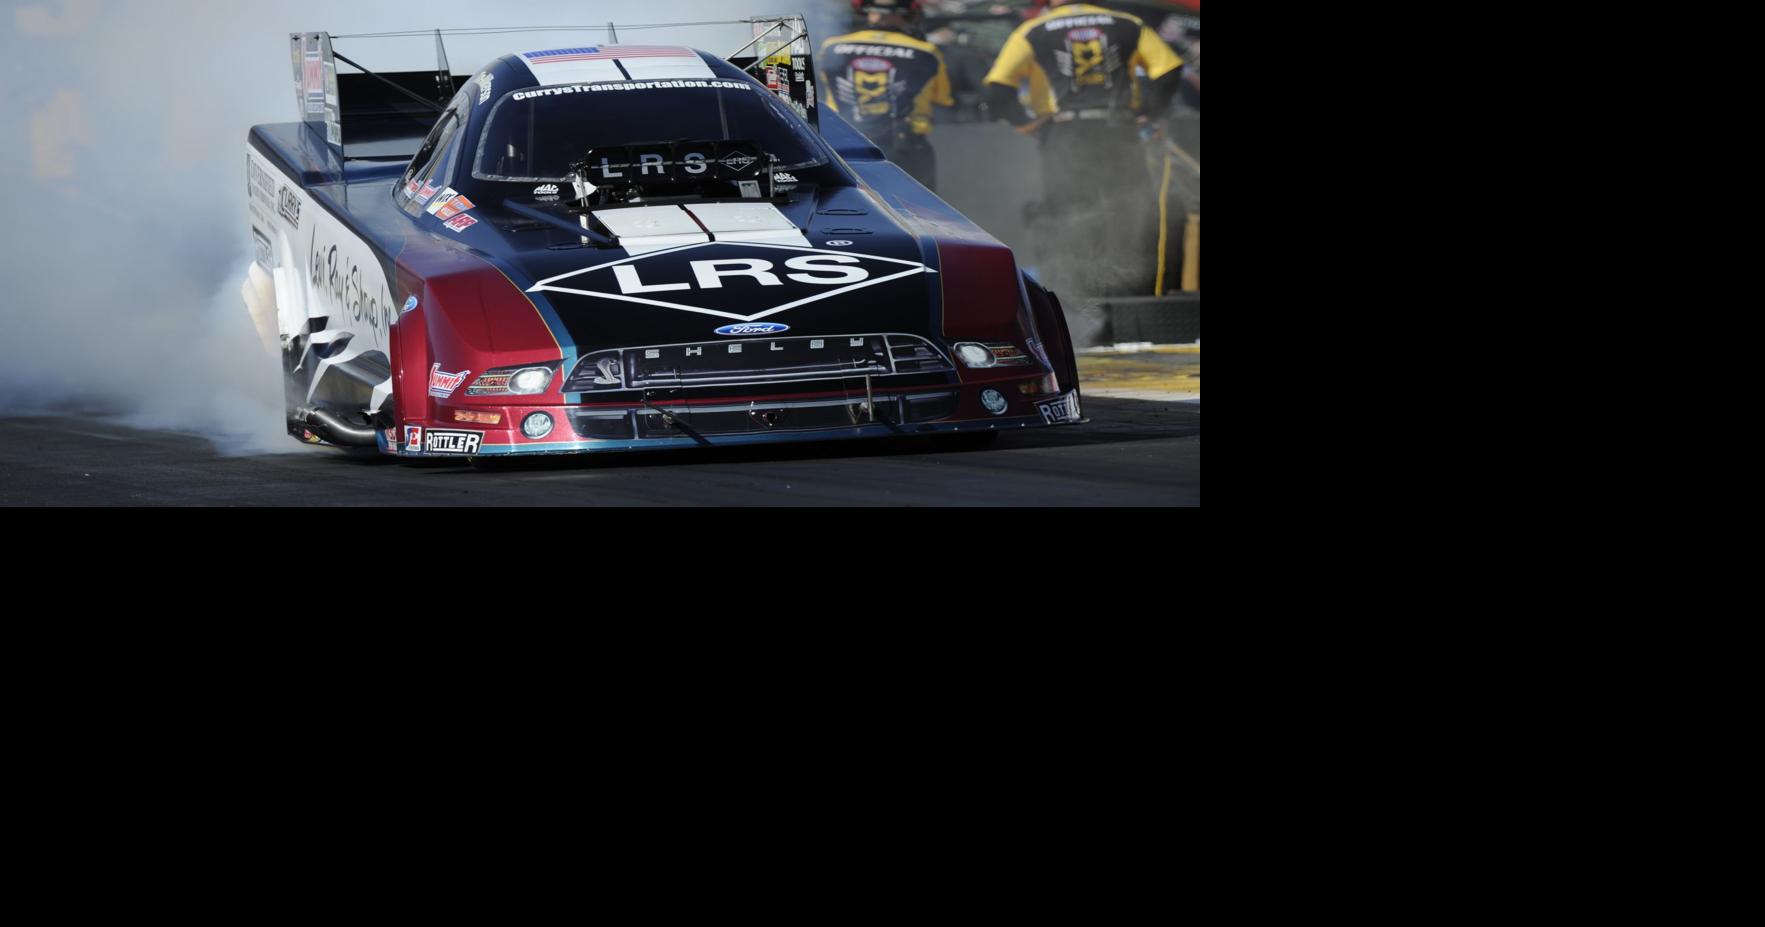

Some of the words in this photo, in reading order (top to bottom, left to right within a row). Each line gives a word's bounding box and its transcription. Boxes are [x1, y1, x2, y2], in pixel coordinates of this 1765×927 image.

[833, 44, 914, 60] OFFICIAL
[611, 254, 870, 295] LRS
[729, 325, 775, 335] Ford
[426, 431, 482, 453] ROTTLER
